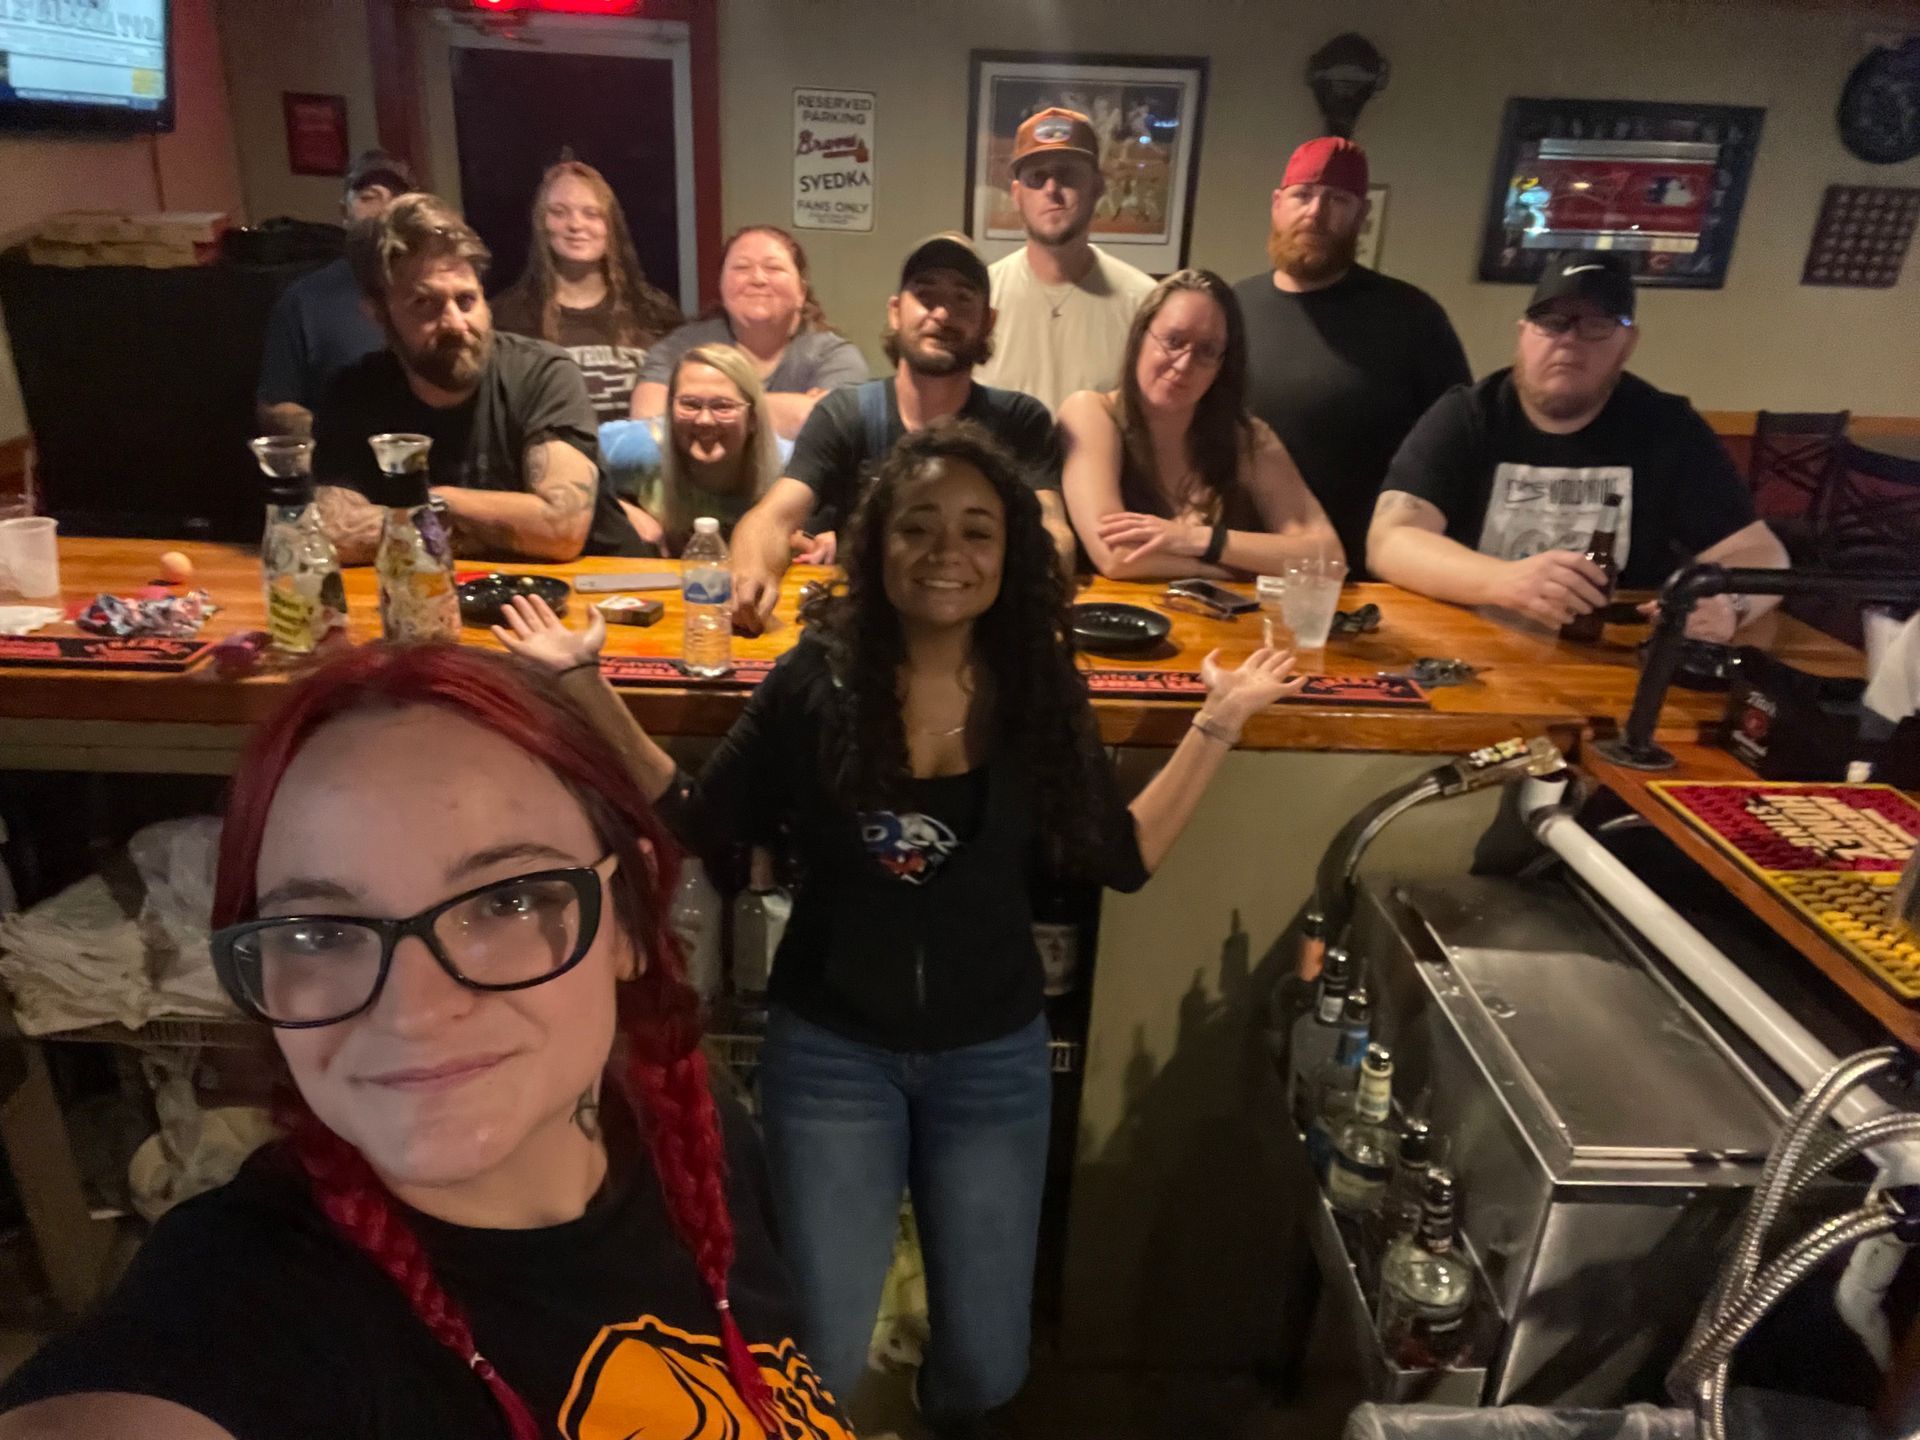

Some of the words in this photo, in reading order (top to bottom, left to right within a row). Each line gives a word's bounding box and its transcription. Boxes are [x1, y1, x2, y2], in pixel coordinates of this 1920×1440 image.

[798, 96, 872, 110] RESERVED
[803, 110, 866, 125] PARKING
[799, 170, 870, 192] SVEDKA
[797, 199, 832, 213] FANS
[834, 202, 869, 214] ONLY
[1743, 799, 1830, 849] STING
[1760, 795, 1895, 860] HONEY
